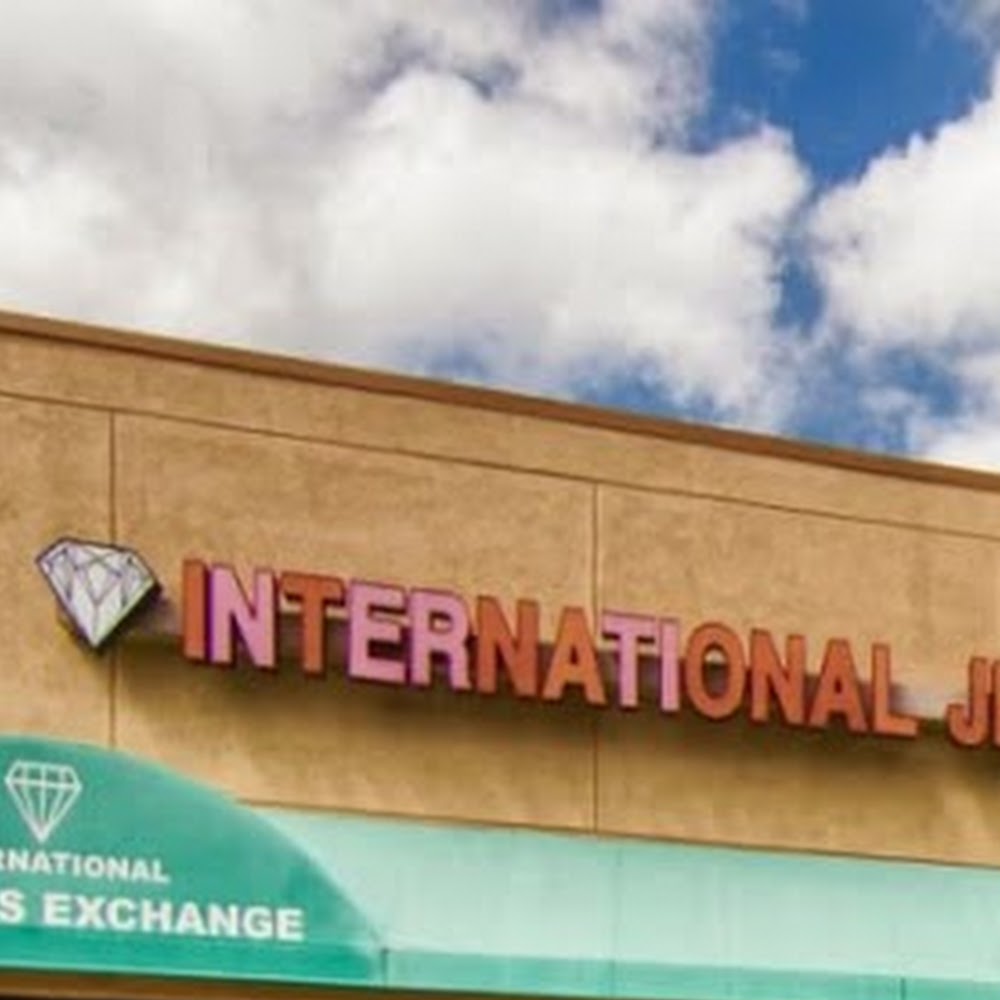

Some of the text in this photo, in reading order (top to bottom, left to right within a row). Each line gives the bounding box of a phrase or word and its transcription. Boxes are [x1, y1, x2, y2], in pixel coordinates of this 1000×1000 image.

[183, 558, 919, 738] INTERNATIONAL
[0, 849, 171, 884] NATIONAL
[42, 891, 305, 941] EXCHANGE
